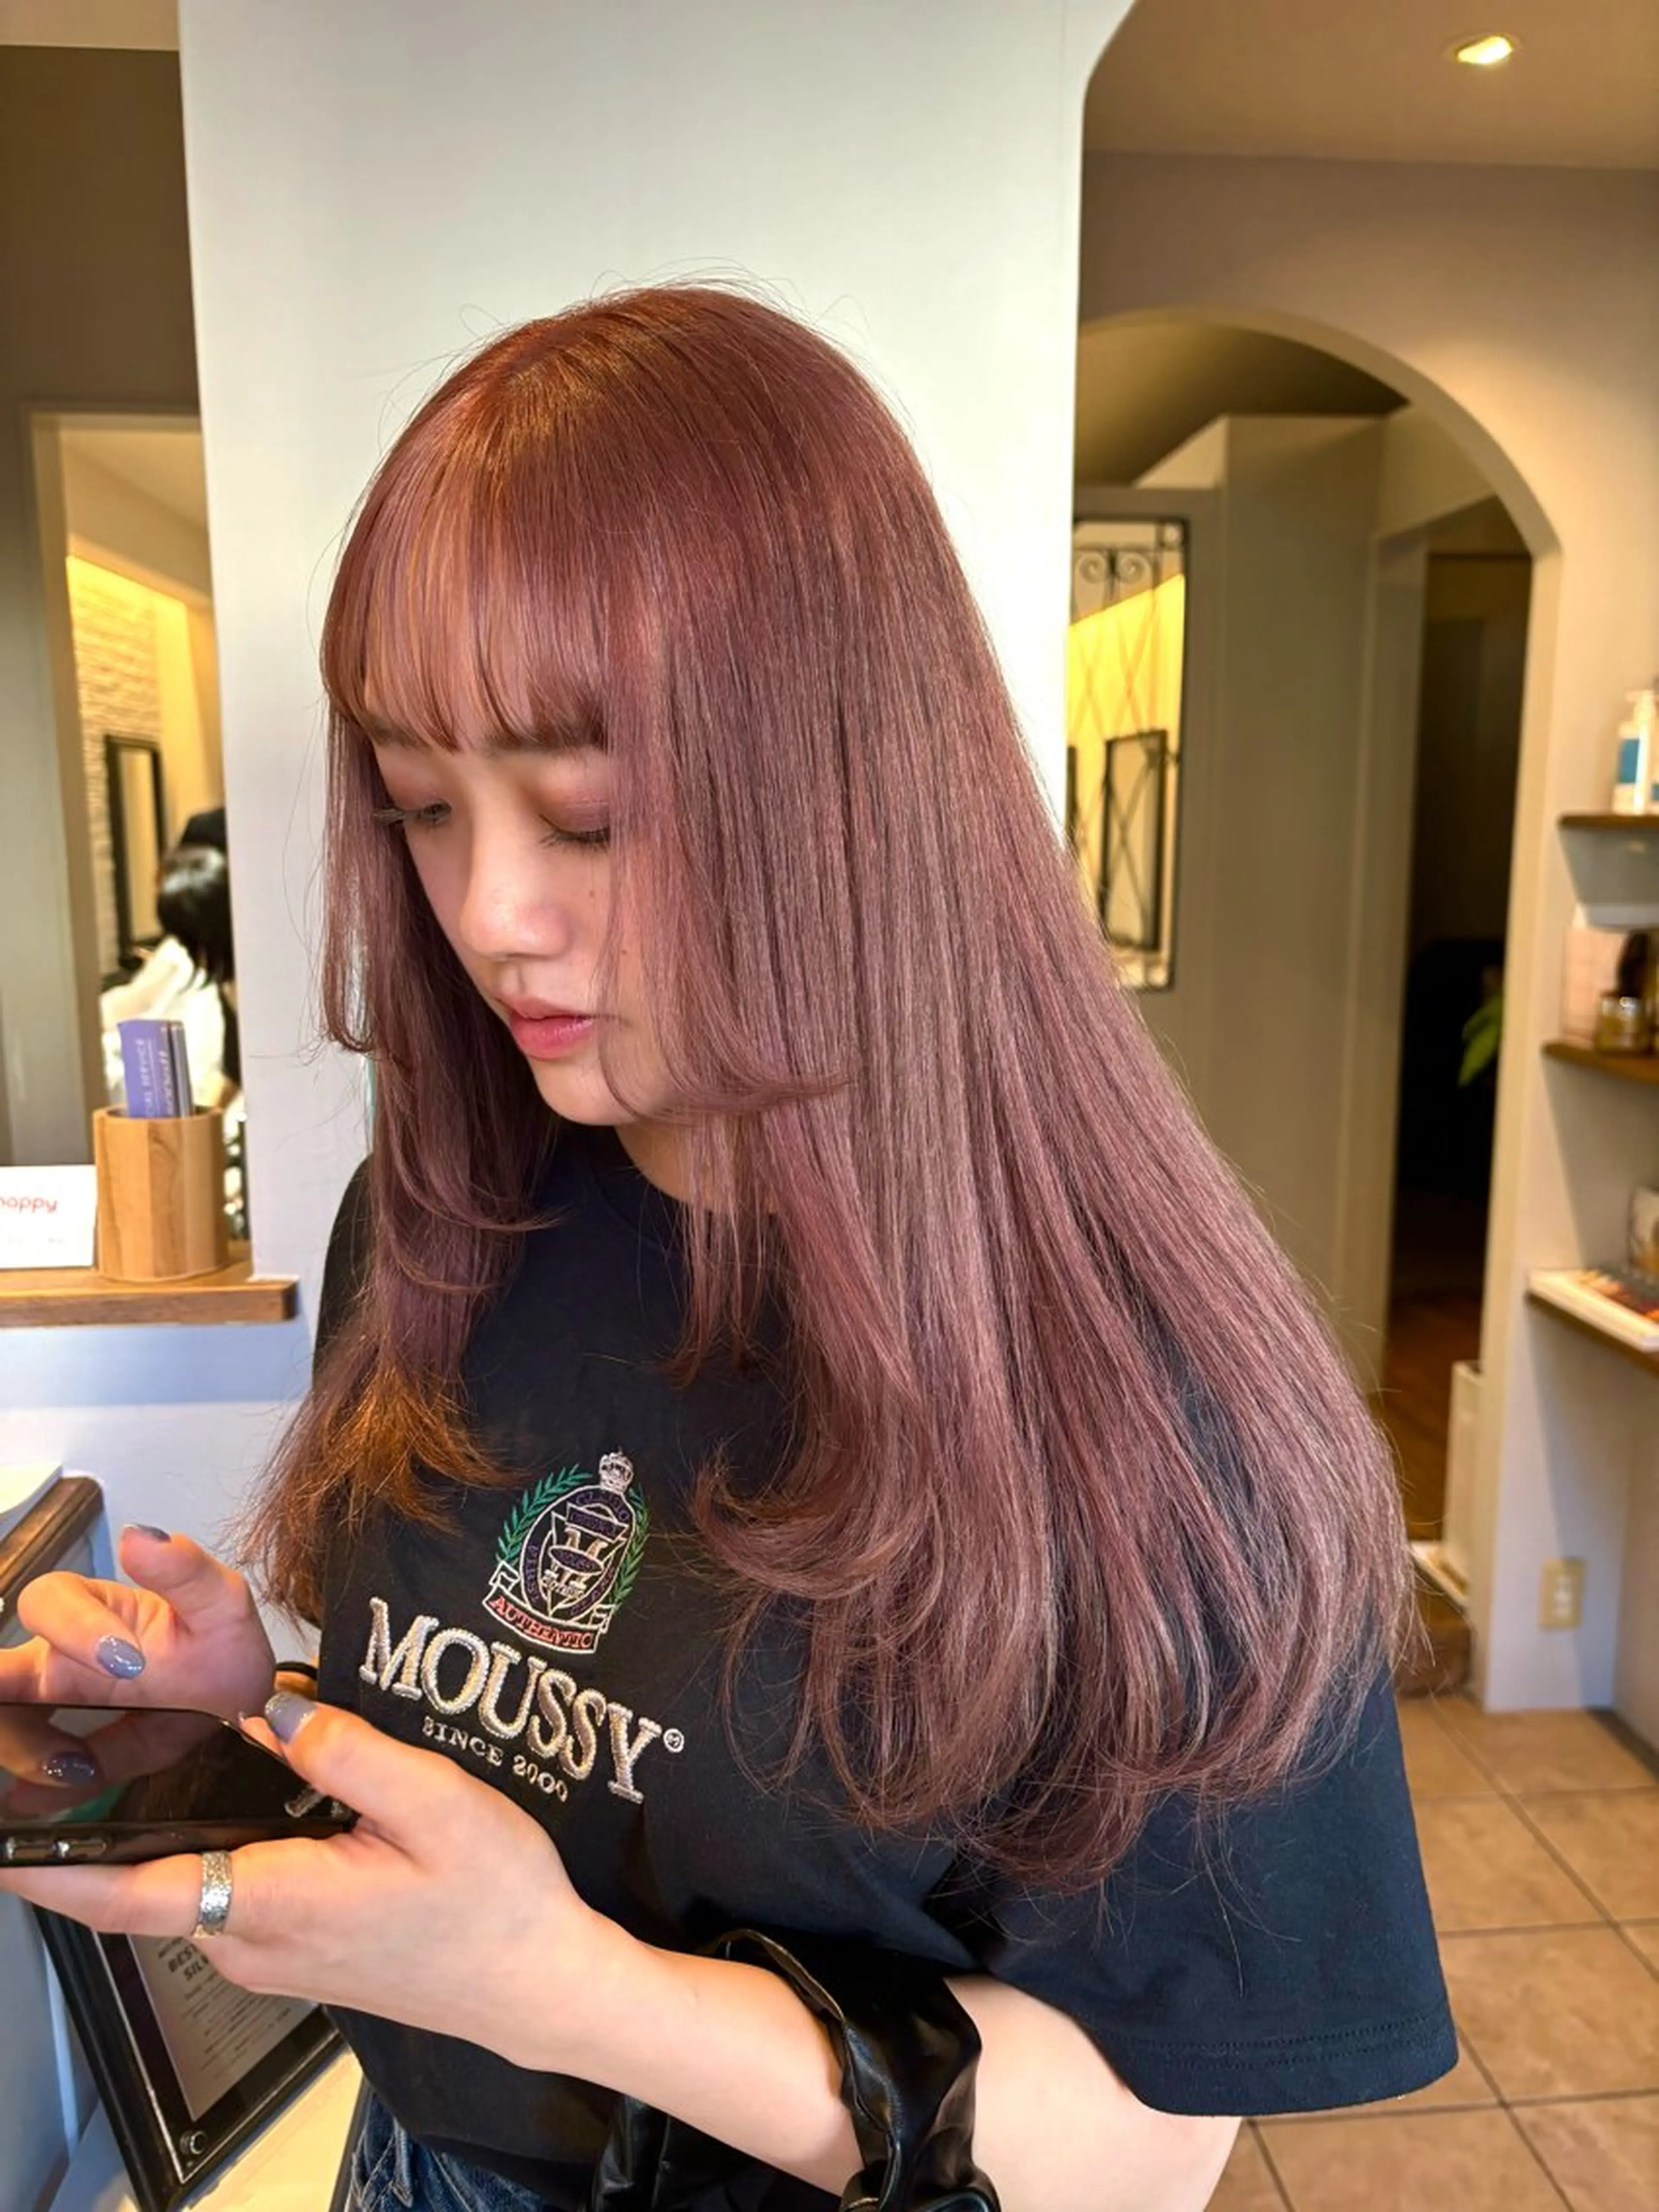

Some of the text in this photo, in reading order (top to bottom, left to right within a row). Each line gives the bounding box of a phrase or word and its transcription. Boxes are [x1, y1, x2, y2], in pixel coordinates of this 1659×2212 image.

[489, 1595, 594, 1649] AUTHENTIC
[359, 1596, 662, 1805] MOUSSY
[421, 1715, 569, 1802] SINCE 2000
